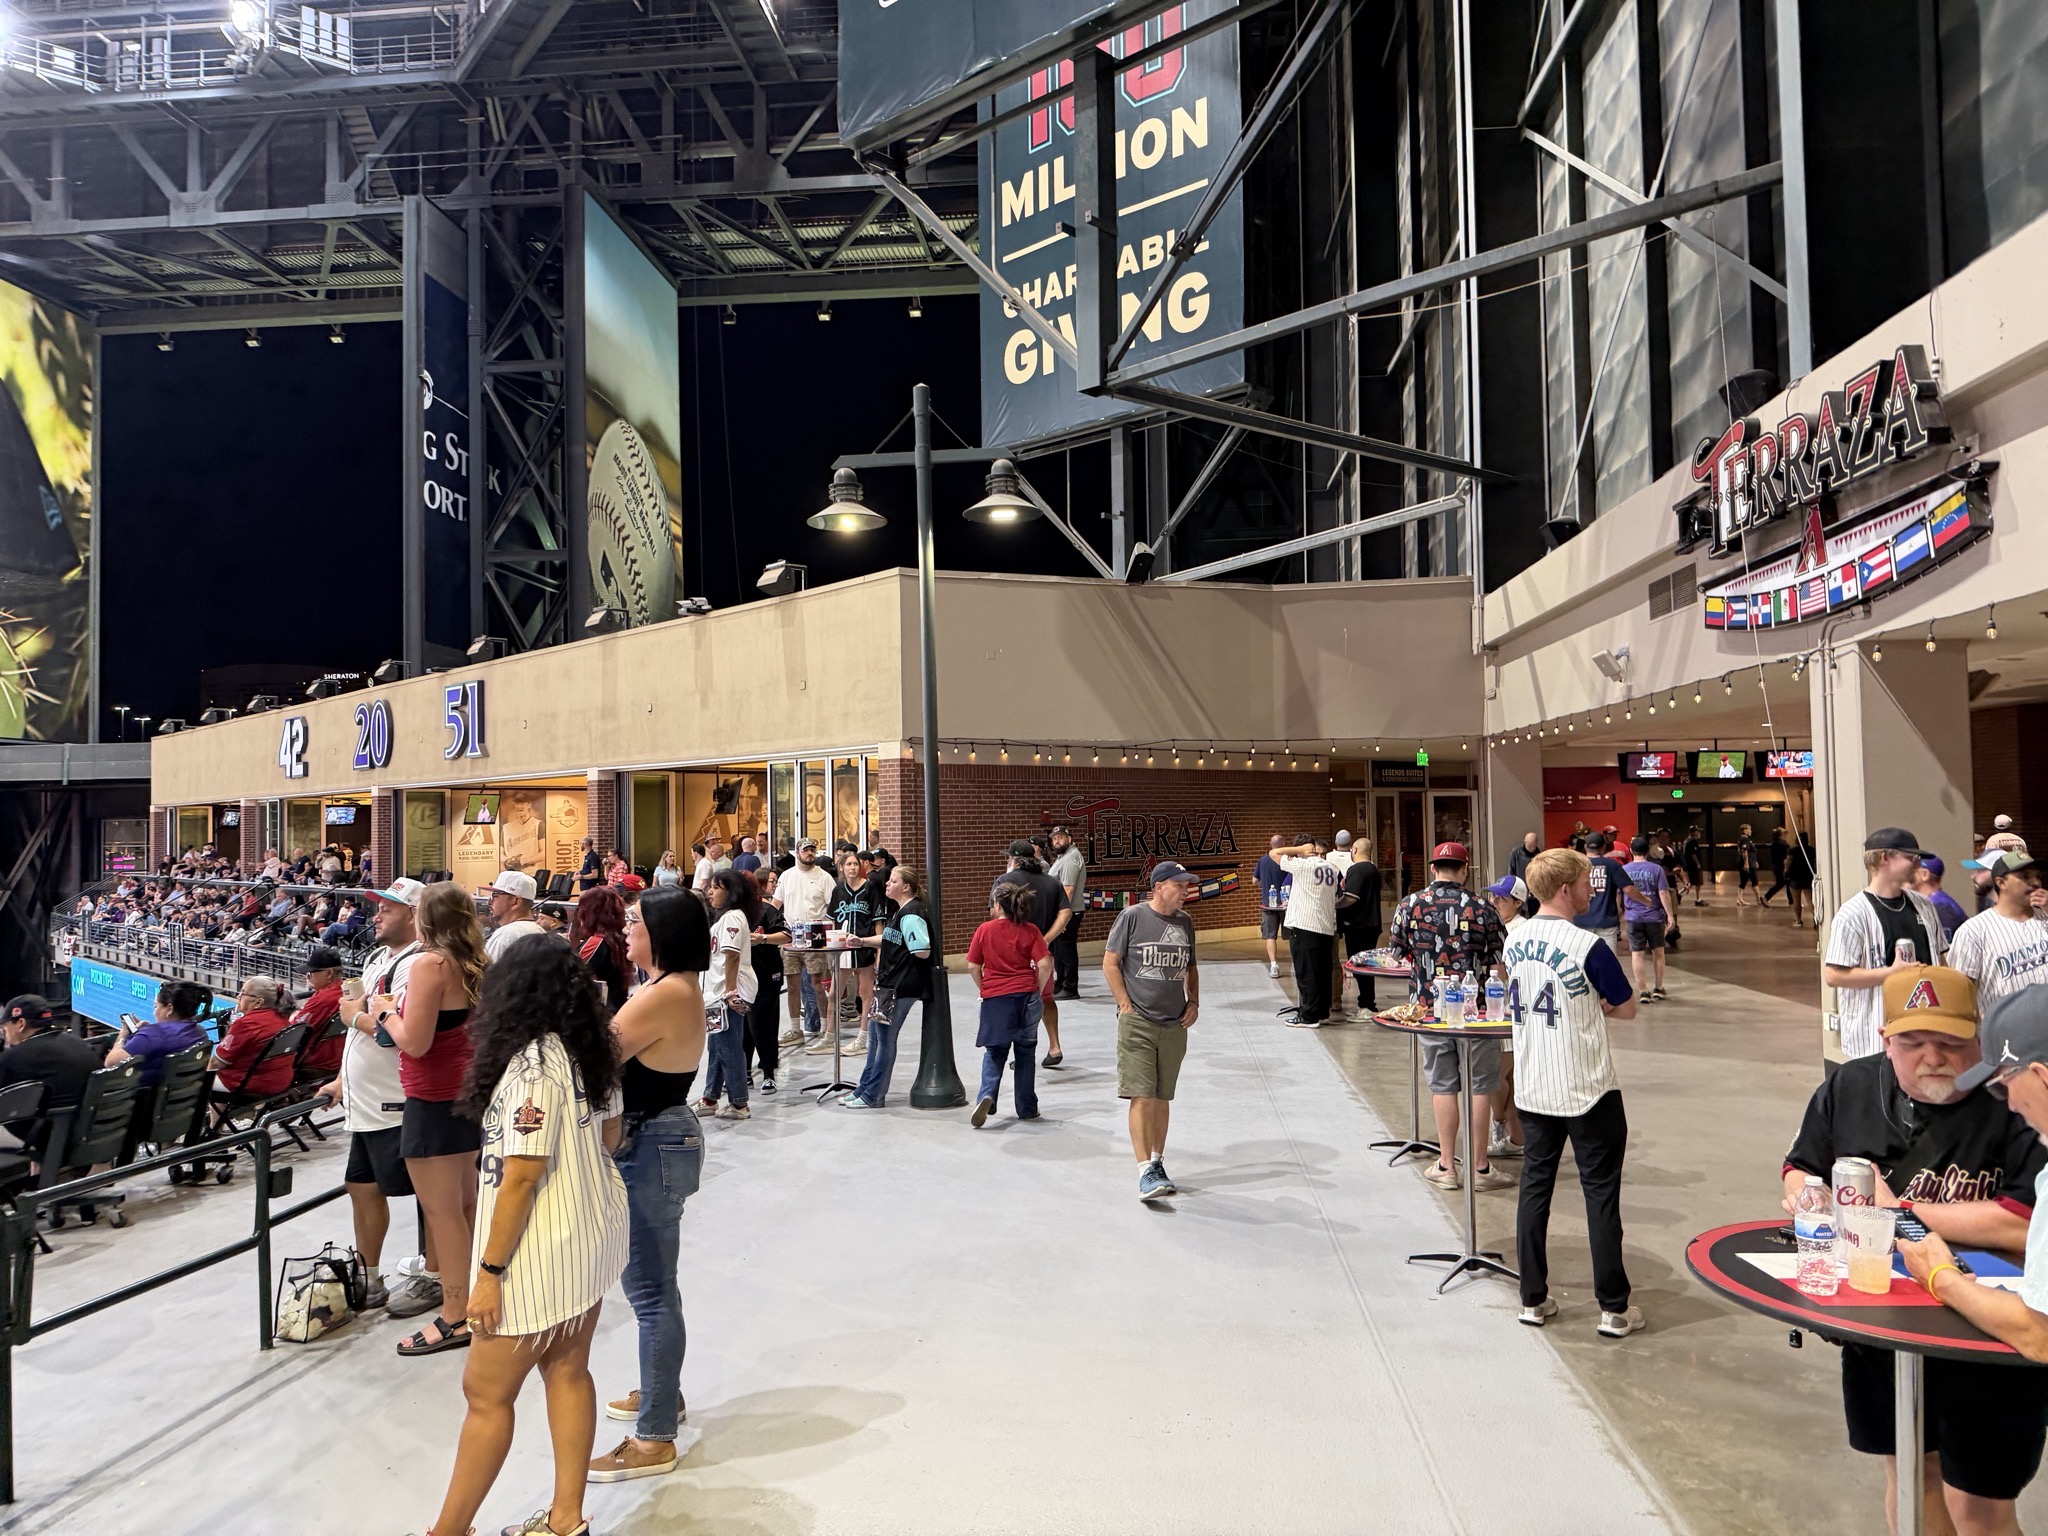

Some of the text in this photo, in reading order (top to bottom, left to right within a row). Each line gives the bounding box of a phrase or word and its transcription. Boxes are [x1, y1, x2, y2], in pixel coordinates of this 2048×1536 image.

[1002, 97, 1208, 228] MILION
[1692, 349, 1928, 560] TERRAZA
[323, 672, 360, 680] SHERATON
[279, 717, 306, 779] 42
[353, 699, 391, 771] 20
[445, 681, 485, 760] 51
[1406, 769, 1424, 777] SUITES
[1066, 796, 1240, 867] TERRAZA
[1314, 866, 1335, 887] 98
[72, 974, 85, 996] COX
[131, 980, 147, 999] SPEED
[1508, 977, 1562, 1030] 44
